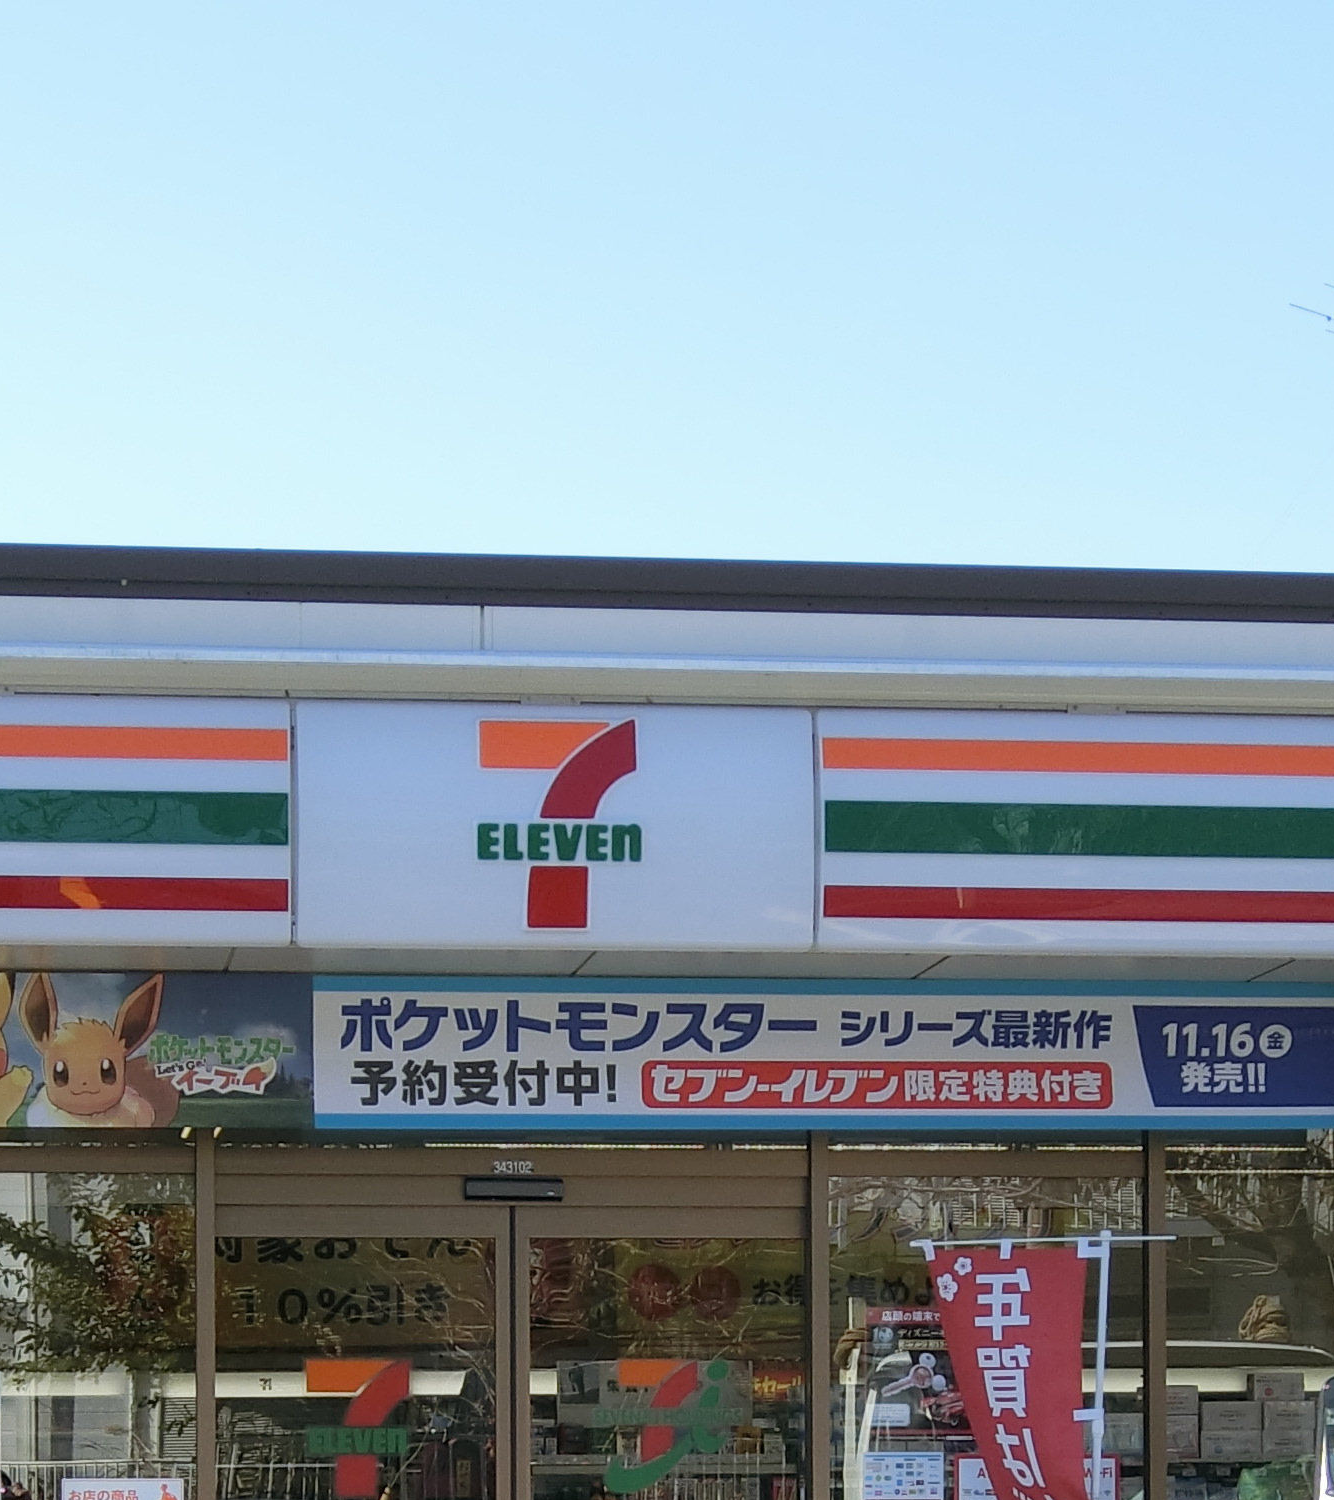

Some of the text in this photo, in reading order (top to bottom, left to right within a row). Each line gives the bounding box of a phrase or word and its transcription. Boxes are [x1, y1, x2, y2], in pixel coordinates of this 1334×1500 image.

[477, 823, 642, 862] ELEVEn
[341, 996, 1113, 1053] ポケットモンスター シリーズ最新作
[148, 1034, 296, 1065] ポケットモンスター
[350, 1060, 618, 1107] 予約受付中!
[1181, 1061, 1266, 1093] 発売!!
[493, 1161, 534, 1173] 343102
